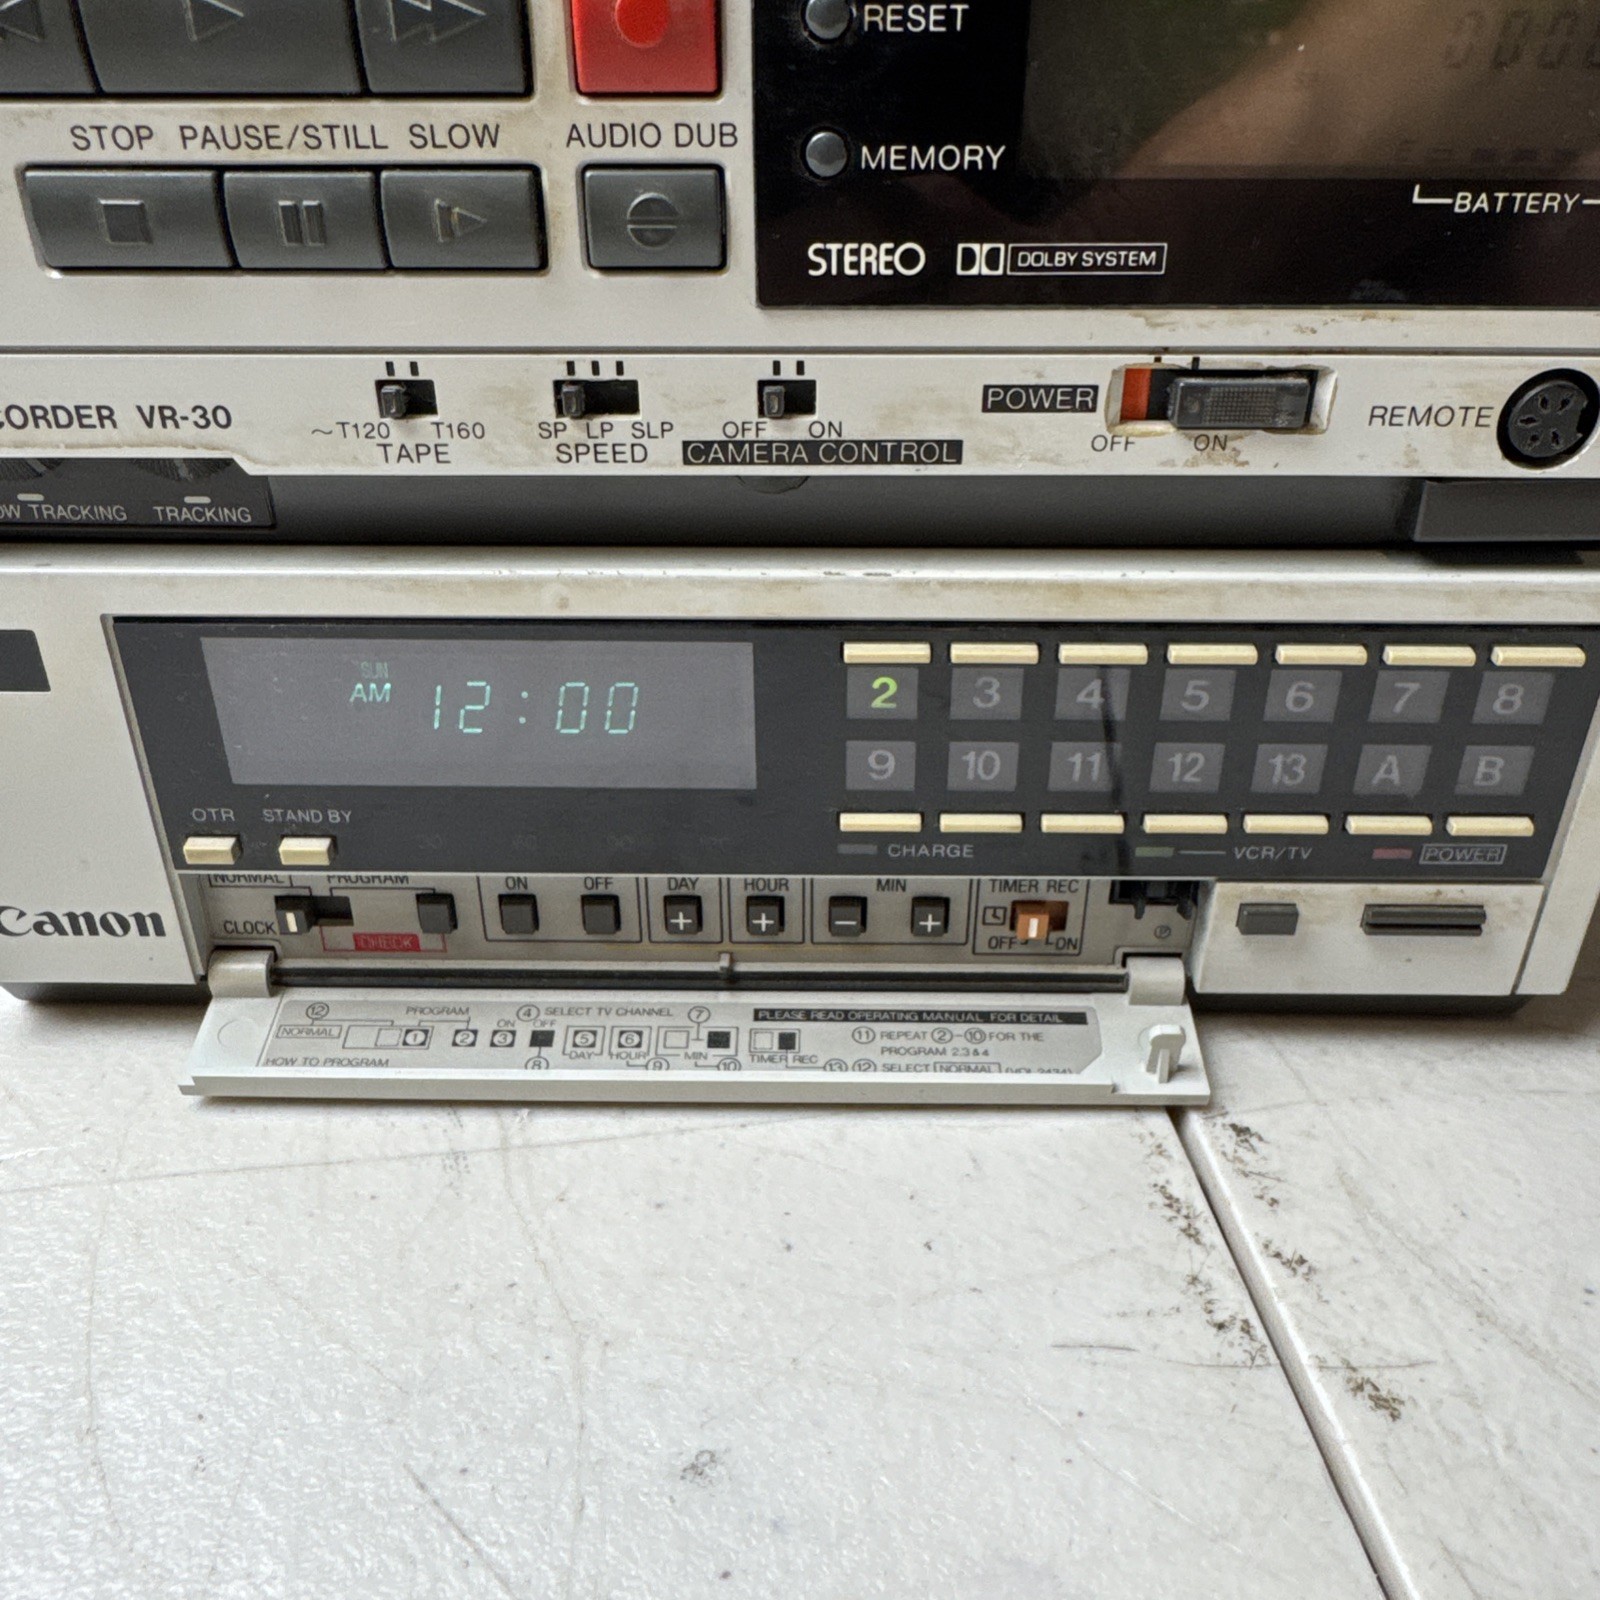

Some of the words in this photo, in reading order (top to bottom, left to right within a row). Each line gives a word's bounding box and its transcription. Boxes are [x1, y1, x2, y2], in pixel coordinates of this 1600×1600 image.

[864, 3, 969, 33] RESET
[70, 125, 154, 151] STOP
[180, 124, 389, 150] PAUSE/STILL
[409, 123, 501, 149] SLOW
[566, 123, 662, 149] AUDIO
[674, 123, 739, 148] DUB
[861, 145, 1006, 171] MEMORY
[1454, 192, 1580, 214] BATTERY
[808, 242, 926, 277] STEREO
[1017, 251, 1078, 268] DOLBY
[1081, 251, 1157, 268] SYSTEM
[986, 387, 1095, 411] POWER
[0, 404, 118, 430] ORDER
[136, 404, 233, 429] VR-30
[1368, 406, 1494, 429] REMOTE
[431, 421, 486, 440] T160
[538, 421, 567, 439] SP
[586, 421, 614, 439] LP
[631, 421, 674, 439] SLP
[722, 421, 768, 439] OFF
[808, 421, 843, 438] ON
[1091, 434, 1136, 452] OFF
[1193, 433, 1228, 452] ON
[376, 443, 451, 464] TAPE
[556, 442, 649, 464] SPEED
[687, 441, 809, 464] CAMERA
[818, 441, 958, 464] CONTROL
[27, 503, 128, 521] TRACKING
[153, 505, 252, 524] TRACKING
[870, 676, 898, 709] 2
[972, 676, 1001, 709] 3
[1076, 677, 1105, 709] 4
[1181, 680, 1210, 712] 5
[1284, 681, 1315, 713] 6
[1393, 682, 1421, 714] 7
[1492, 683, 1525, 715] 8
[349, 682, 392, 703] AM
[431, 681, 640, 734] 12:00
[867, 750, 896, 781] 9
[961, 750, 1001, 781] 10
[1067, 752, 1102, 782] 11
[1167, 752, 1206, 783] 12
[1268, 753, 1307, 785] 13
[1371, 755, 1401, 786] A
[1474, 755, 1504, 787] B
[191, 808, 236, 822] OTR
[262, 808, 323, 824] STAND
[327, 809, 352, 823] BY
[887, 844, 974, 858] CHARGE
[1234, 847, 1313, 861] VCR/TV
[1424, 847, 1502, 862] POWER
[505, 876, 528, 891] ON
[584, 876, 614, 891] OFF
[668, 877, 699, 891] DAY
[744, 877, 790, 892] HOUR
[876, 878, 907, 893] MIN
[989, 879, 1039, 894] TIMER
[1046, 879, 1079, 894] REC
[0, 905, 167, 938] Canon
[223, 920, 277, 935] CLOCK
[360, 935, 412, 948] CHECK
[988, 937, 1015, 949] OFF
[1055, 937, 1079, 950] ON
[406, 1006, 470, 1016] PROGRAM
[544, 1006, 592, 1016] SELECT
[597, 1006, 613, 1016] TV
[615, 1007, 674, 1017] CHANNEL
[758, 1010, 807, 1020] PLEASE
[810, 1011, 845, 1021] READ
[848, 1011, 919, 1021] OPERATING
[922, 1012, 984, 1022] MANUAL
[990, 1013, 1018, 1023] FOR
[1020, 1013, 1063, 1024] DETAIL
[281, 1027, 335, 1037] NORMAL
[497, 1019, 516, 1028] ON
[533, 1019, 557, 1029] OFF
[880, 1030, 928, 1040] REPEAT
[989, 1031, 1016, 1041] FOR
[1020, 1031, 1044, 1041] THE
[568, 1050, 595, 1060] DAY
[610, 1051, 647, 1060] HOUR
[684, 1051, 708, 1060] MIN
[751, 1054, 788, 1064] TIMER
[792, 1055, 818, 1064] REC
[880, 1046, 947, 1056] PROGRAM
[266, 1057, 298, 1067] HOW
[303, 1057, 321, 1066] TO
[323, 1057, 389, 1067] PROGRAM
[881, 1063, 930, 1072] SELECT
[939, 1064, 992, 1073] NORMAL
